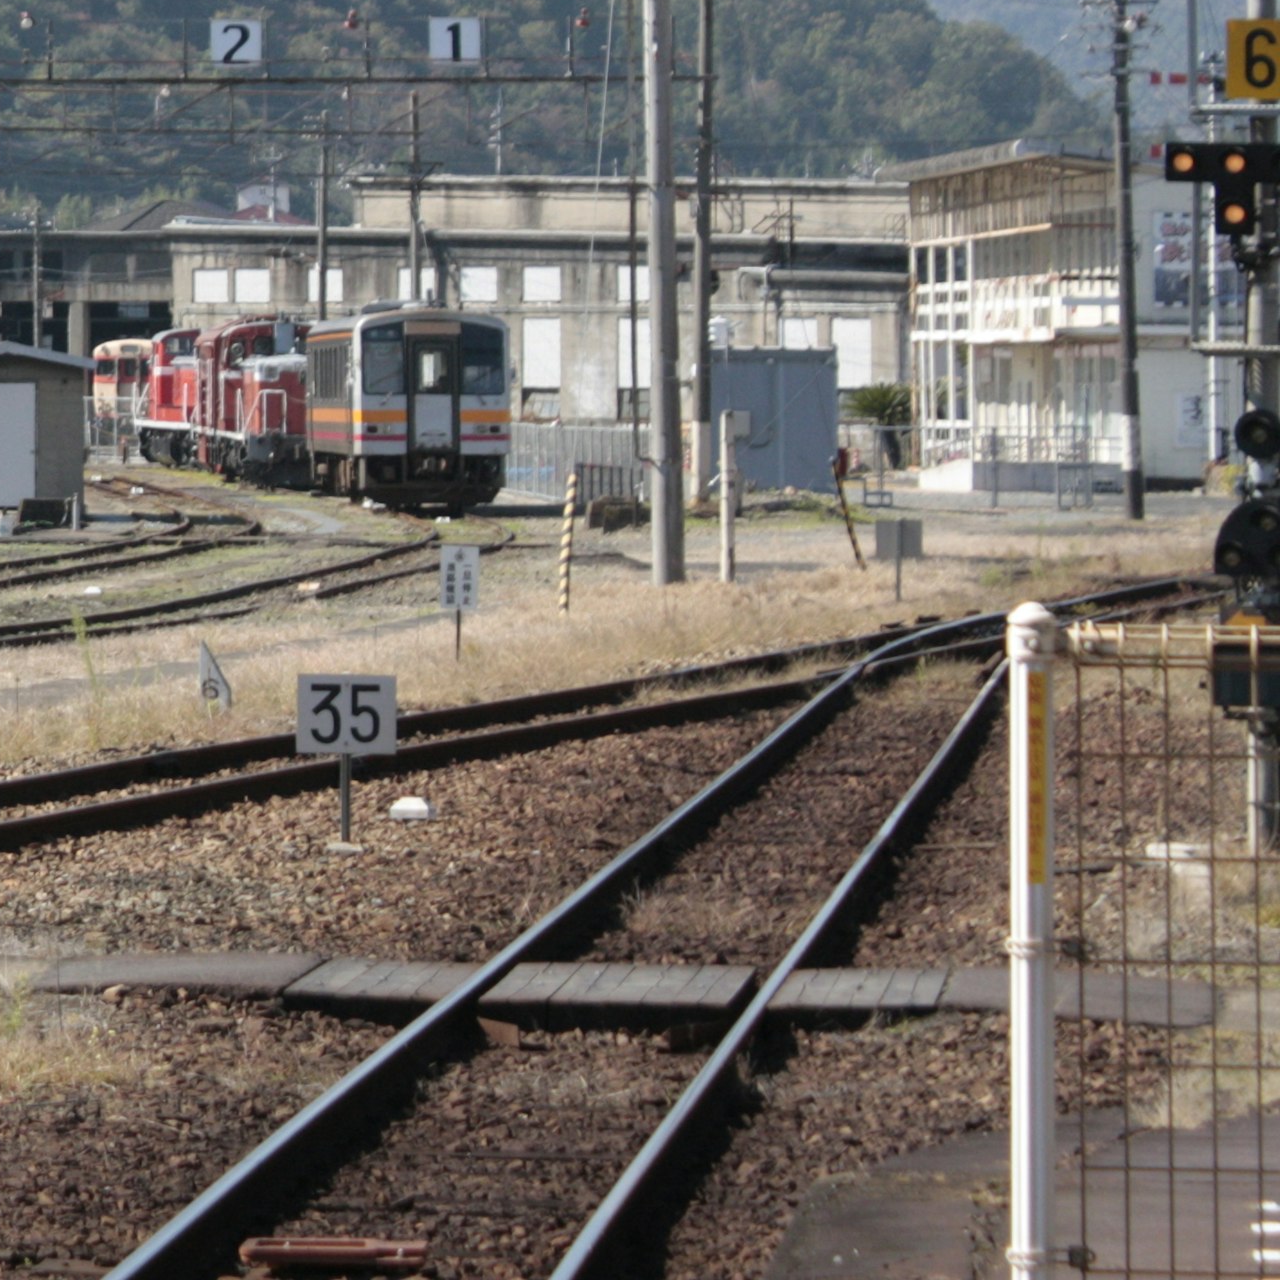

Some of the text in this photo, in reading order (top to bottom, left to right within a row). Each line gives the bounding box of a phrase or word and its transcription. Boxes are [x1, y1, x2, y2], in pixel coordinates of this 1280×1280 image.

[221, 23, 251, 65] 2
[446, 22, 462, 62] 1
[1244, 28, 1277, 88] 6
[310, 683, 381, 745] 35
